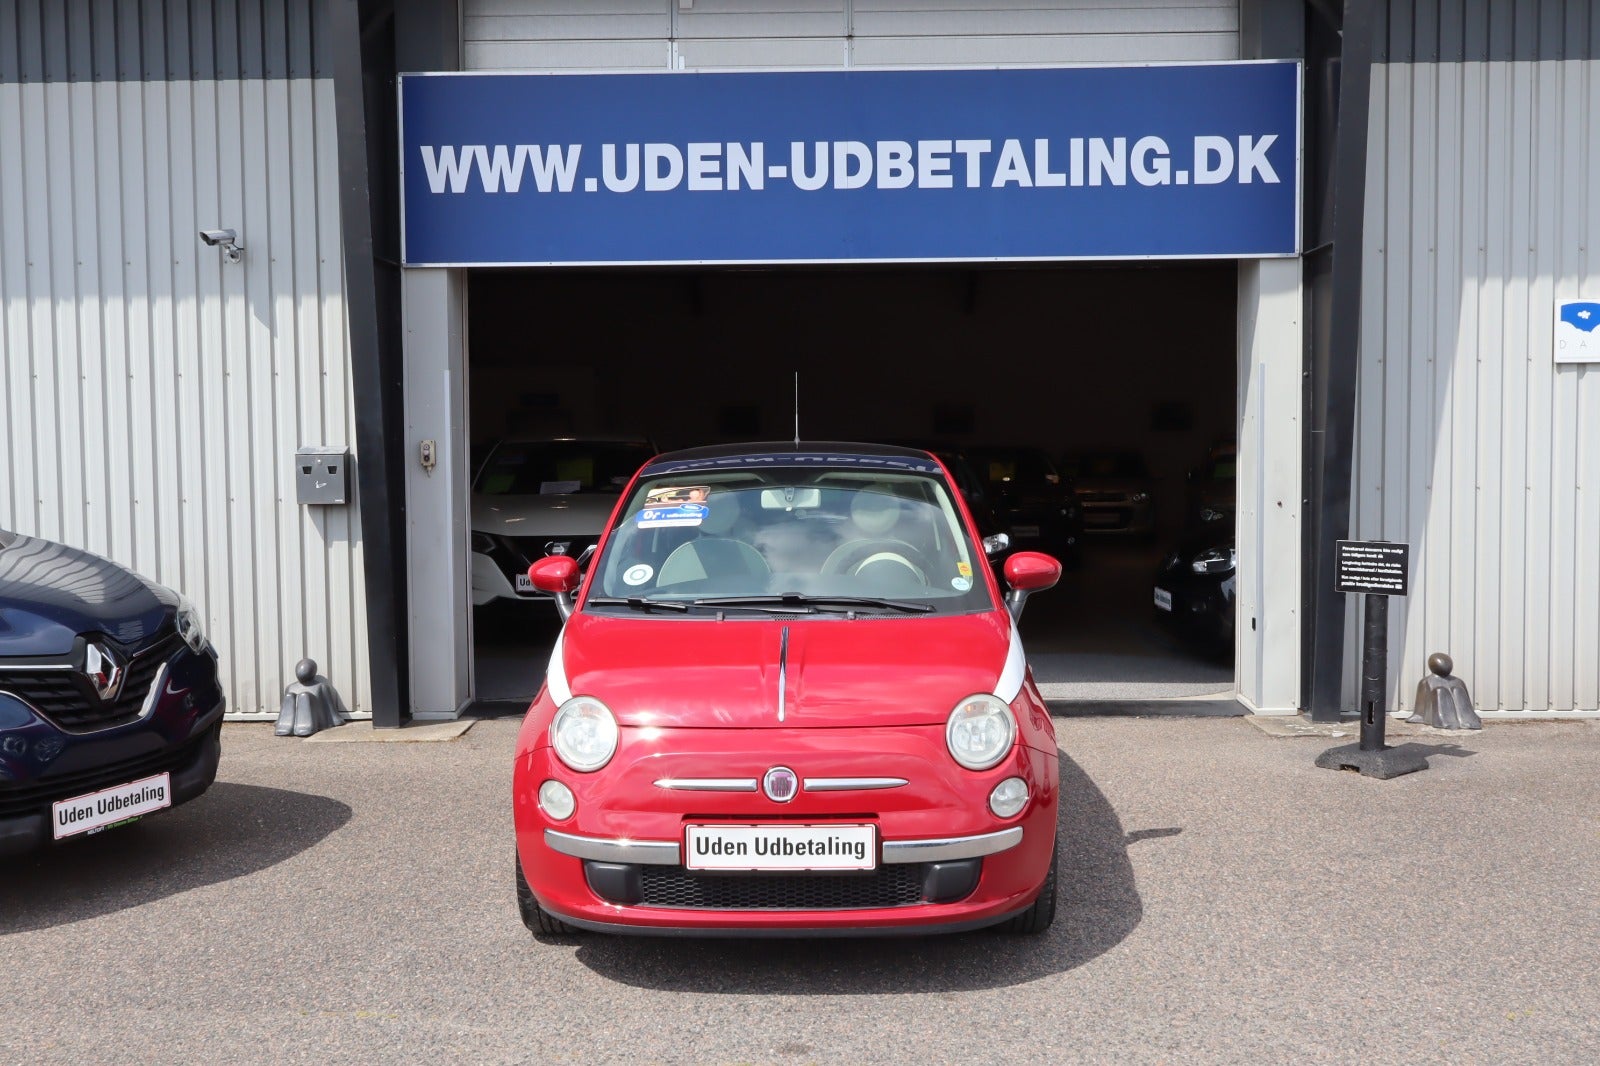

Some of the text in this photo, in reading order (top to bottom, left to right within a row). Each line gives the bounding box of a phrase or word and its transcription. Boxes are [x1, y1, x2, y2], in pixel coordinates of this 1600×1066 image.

[419, 133, 1281, 194] WWW.UDEN-UDBETALING.DK
[59, 807, 93, 825] Uden
[98, 786, 164, 815] Udbetaling
[696, 836, 865, 859] Uden Udbetaling
